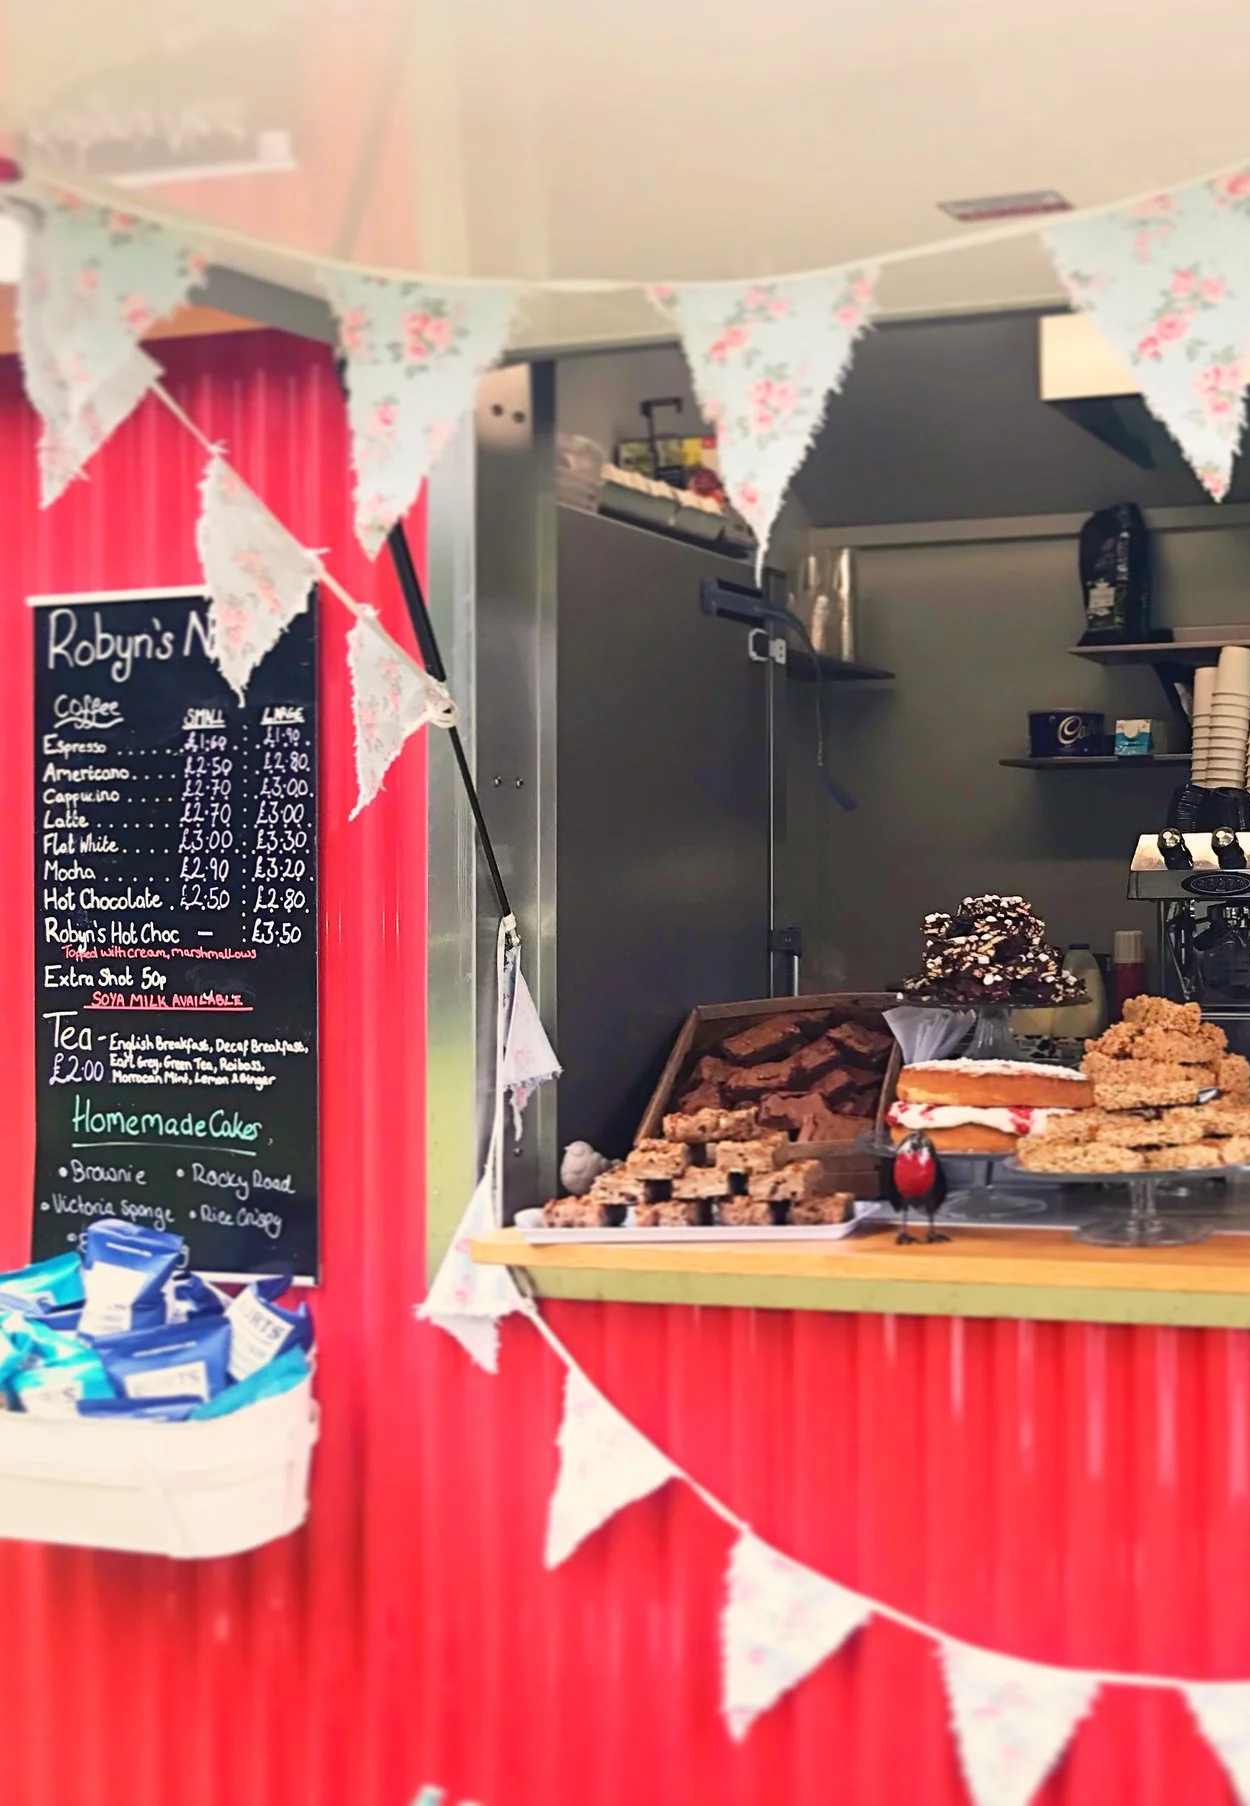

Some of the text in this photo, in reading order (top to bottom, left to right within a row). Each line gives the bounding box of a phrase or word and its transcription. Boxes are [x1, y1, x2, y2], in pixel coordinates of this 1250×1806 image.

[48, 608, 218, 682] Robyn's N
[54, 695, 120, 728] Coffee
[43, 735, 107, 758] Espresso
[42, 762, 130, 782] Americano
[43, 810, 89, 829] Latte
[43, 833, 75, 855] Flat
[80, 836, 118, 854] White
[43, 860, 96, 880] Mocha
[43, 889, 76, 910] Hot
[80, 887, 163, 909] Chocolate
[44, 917, 106, 952] Robyn's
[111, 921, 137, 942] Hot
[140, 922, 180, 944] Choc
[61, 945, 257, 962] Topped with cream, marshmallows
[44, 964, 167, 991] Extra Shot 50p
[92, 990, 243, 1008] SOYA MILK AVAILABLE
[43, 1011, 93, 1051] Tea
[109, 1033, 154, 1055] English
[215, 1038, 249, 1056] Decaf
[110, 1053, 136, 1068] Earl
[164, 1056, 192, 1071] Green
[194, 1072, 228, 1085] Lemon
[72, 1094, 262, 1140] Homemade Cakes
[71, 1159, 147, 1185] Brownie
[192, 1163, 296, 1200] Rocky Road
[52, 1193, 175, 1231] Victoria Sponge
[200, 1204, 282, 1239] Rice Crispy
[235, 1300, 285, 1340] URTS
